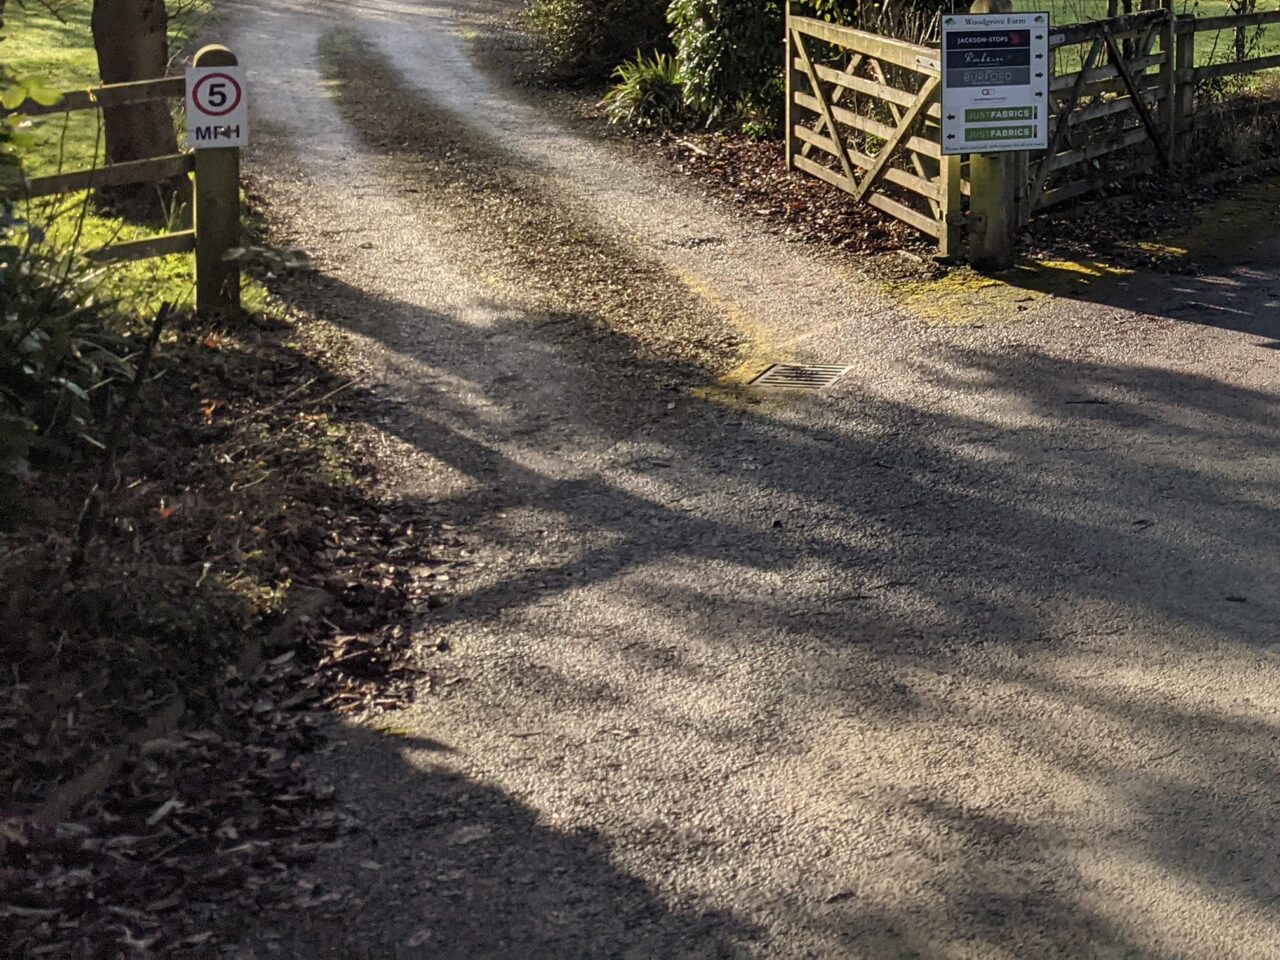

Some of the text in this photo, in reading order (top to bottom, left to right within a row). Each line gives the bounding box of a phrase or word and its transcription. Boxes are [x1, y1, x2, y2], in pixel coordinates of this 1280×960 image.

[964, 17, 1026, 26] Woodgrove Farm
[957, 36, 1009, 44] JACKSON-STOPS
[963, 72, 1013, 82] BURFORD
[208, 83, 227, 107] 5
